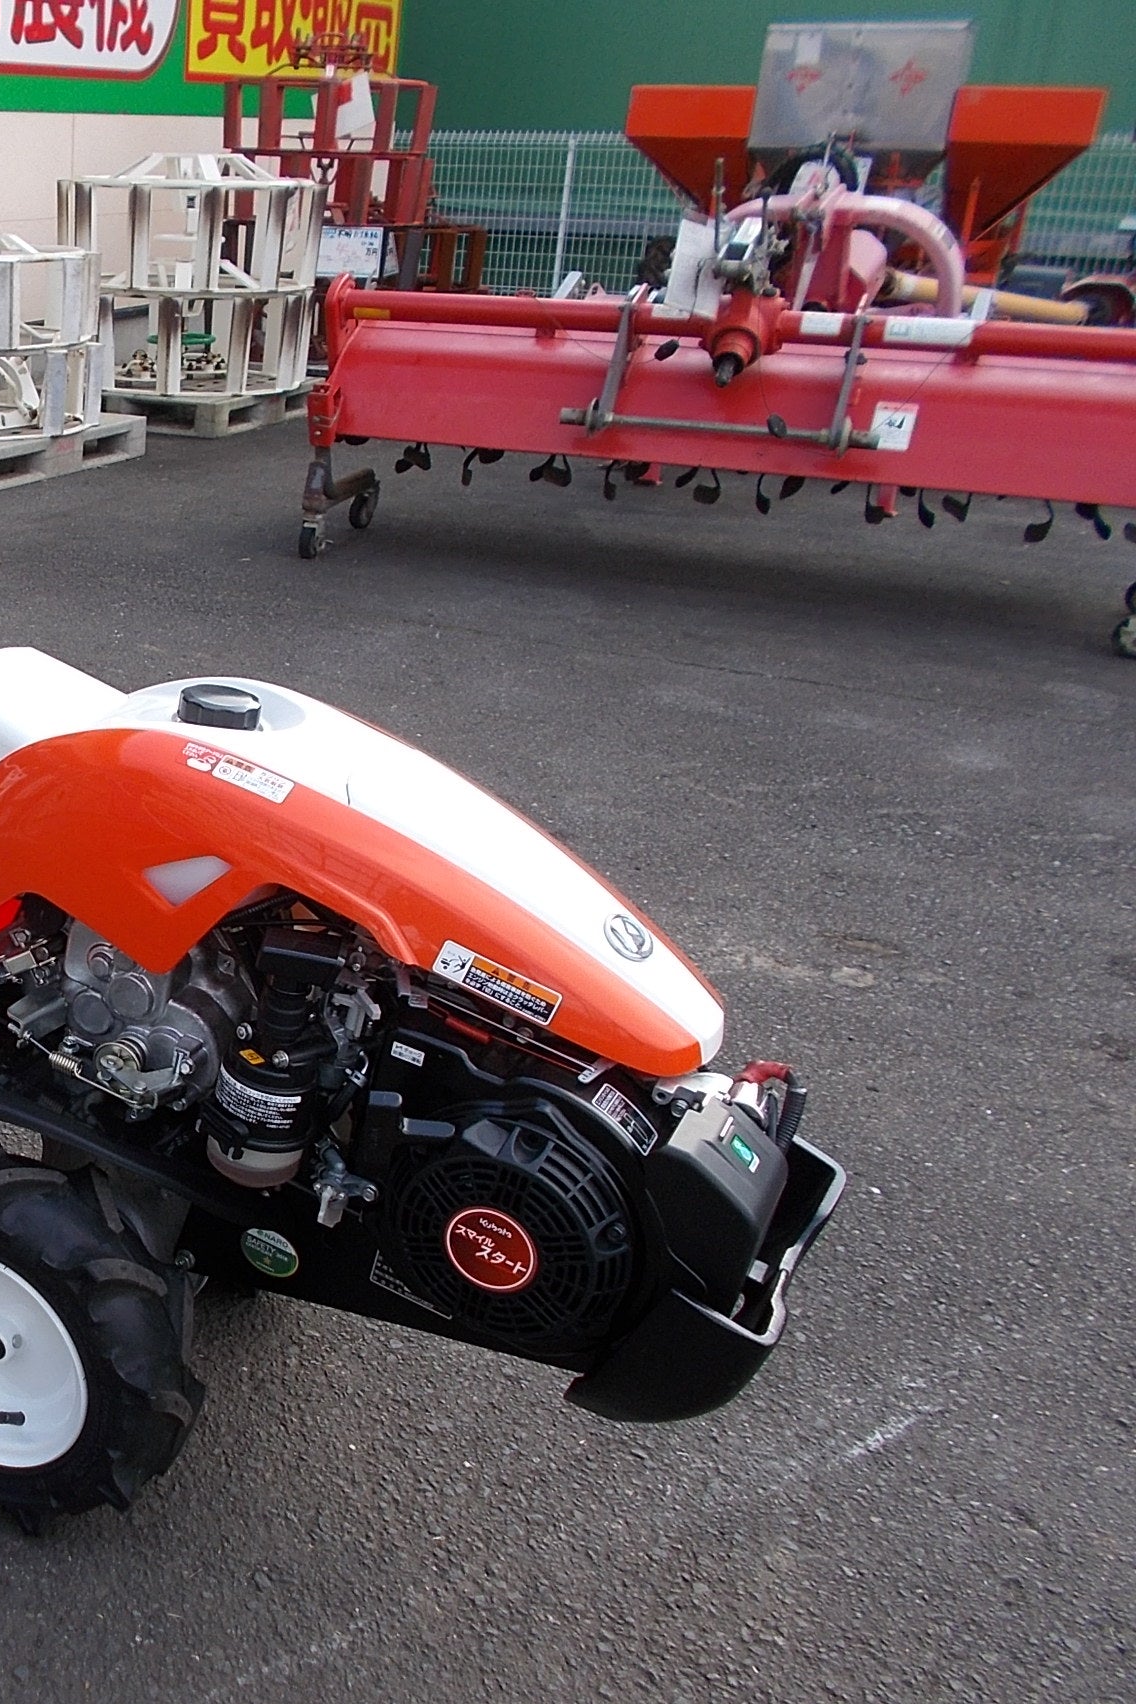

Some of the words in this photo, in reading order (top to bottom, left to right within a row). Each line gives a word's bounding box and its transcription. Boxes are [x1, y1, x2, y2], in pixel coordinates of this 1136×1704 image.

[455, 1224, 496, 1248] スマイル
[479, 1217, 512, 1239] Kubota
[246, 1235, 276, 1254] SAFETY
[475, 1245, 527, 1275] スタート
